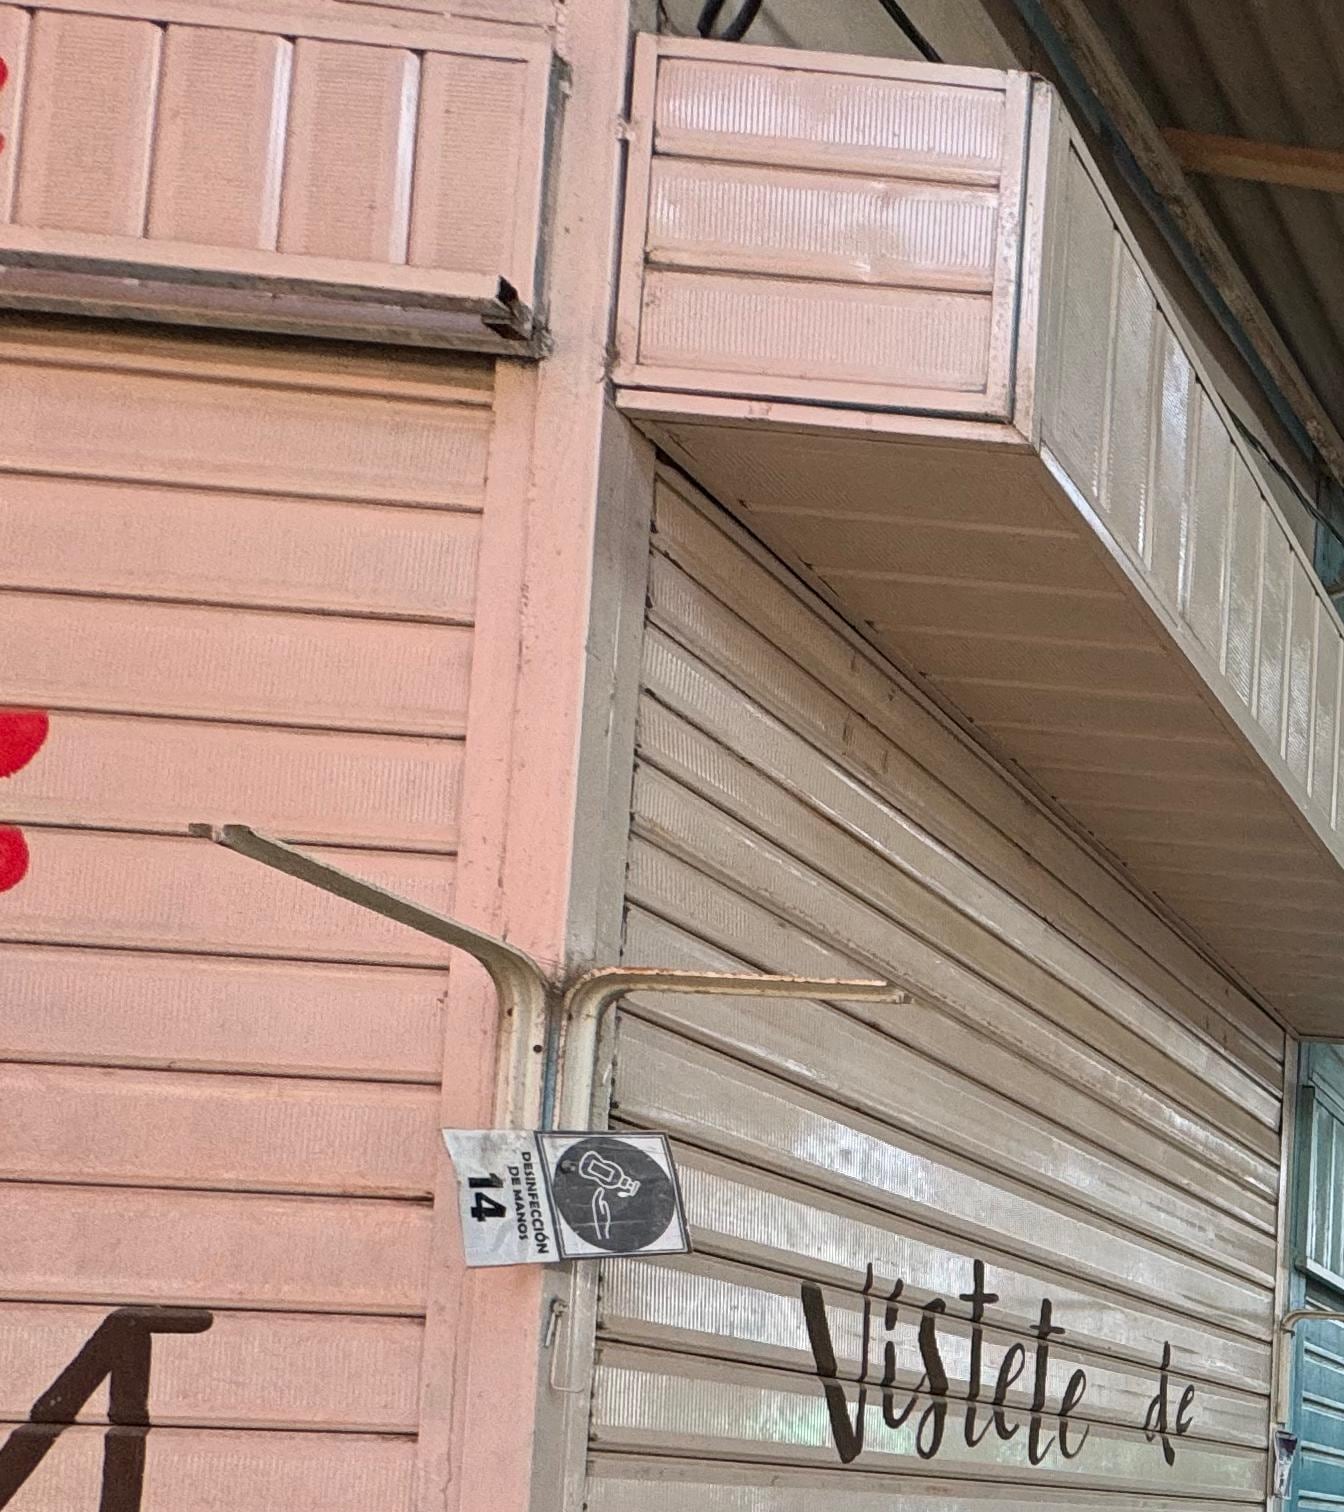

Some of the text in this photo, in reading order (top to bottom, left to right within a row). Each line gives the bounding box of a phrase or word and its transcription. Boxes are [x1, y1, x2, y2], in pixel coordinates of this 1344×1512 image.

[467, 1173, 507, 1222] 14
[508, 1166, 528, 1240] DE MANOS
[522, 1152, 549, 1254] DESINFECCIÓN
[801, 1259, 1195, 1467] Vistete de
